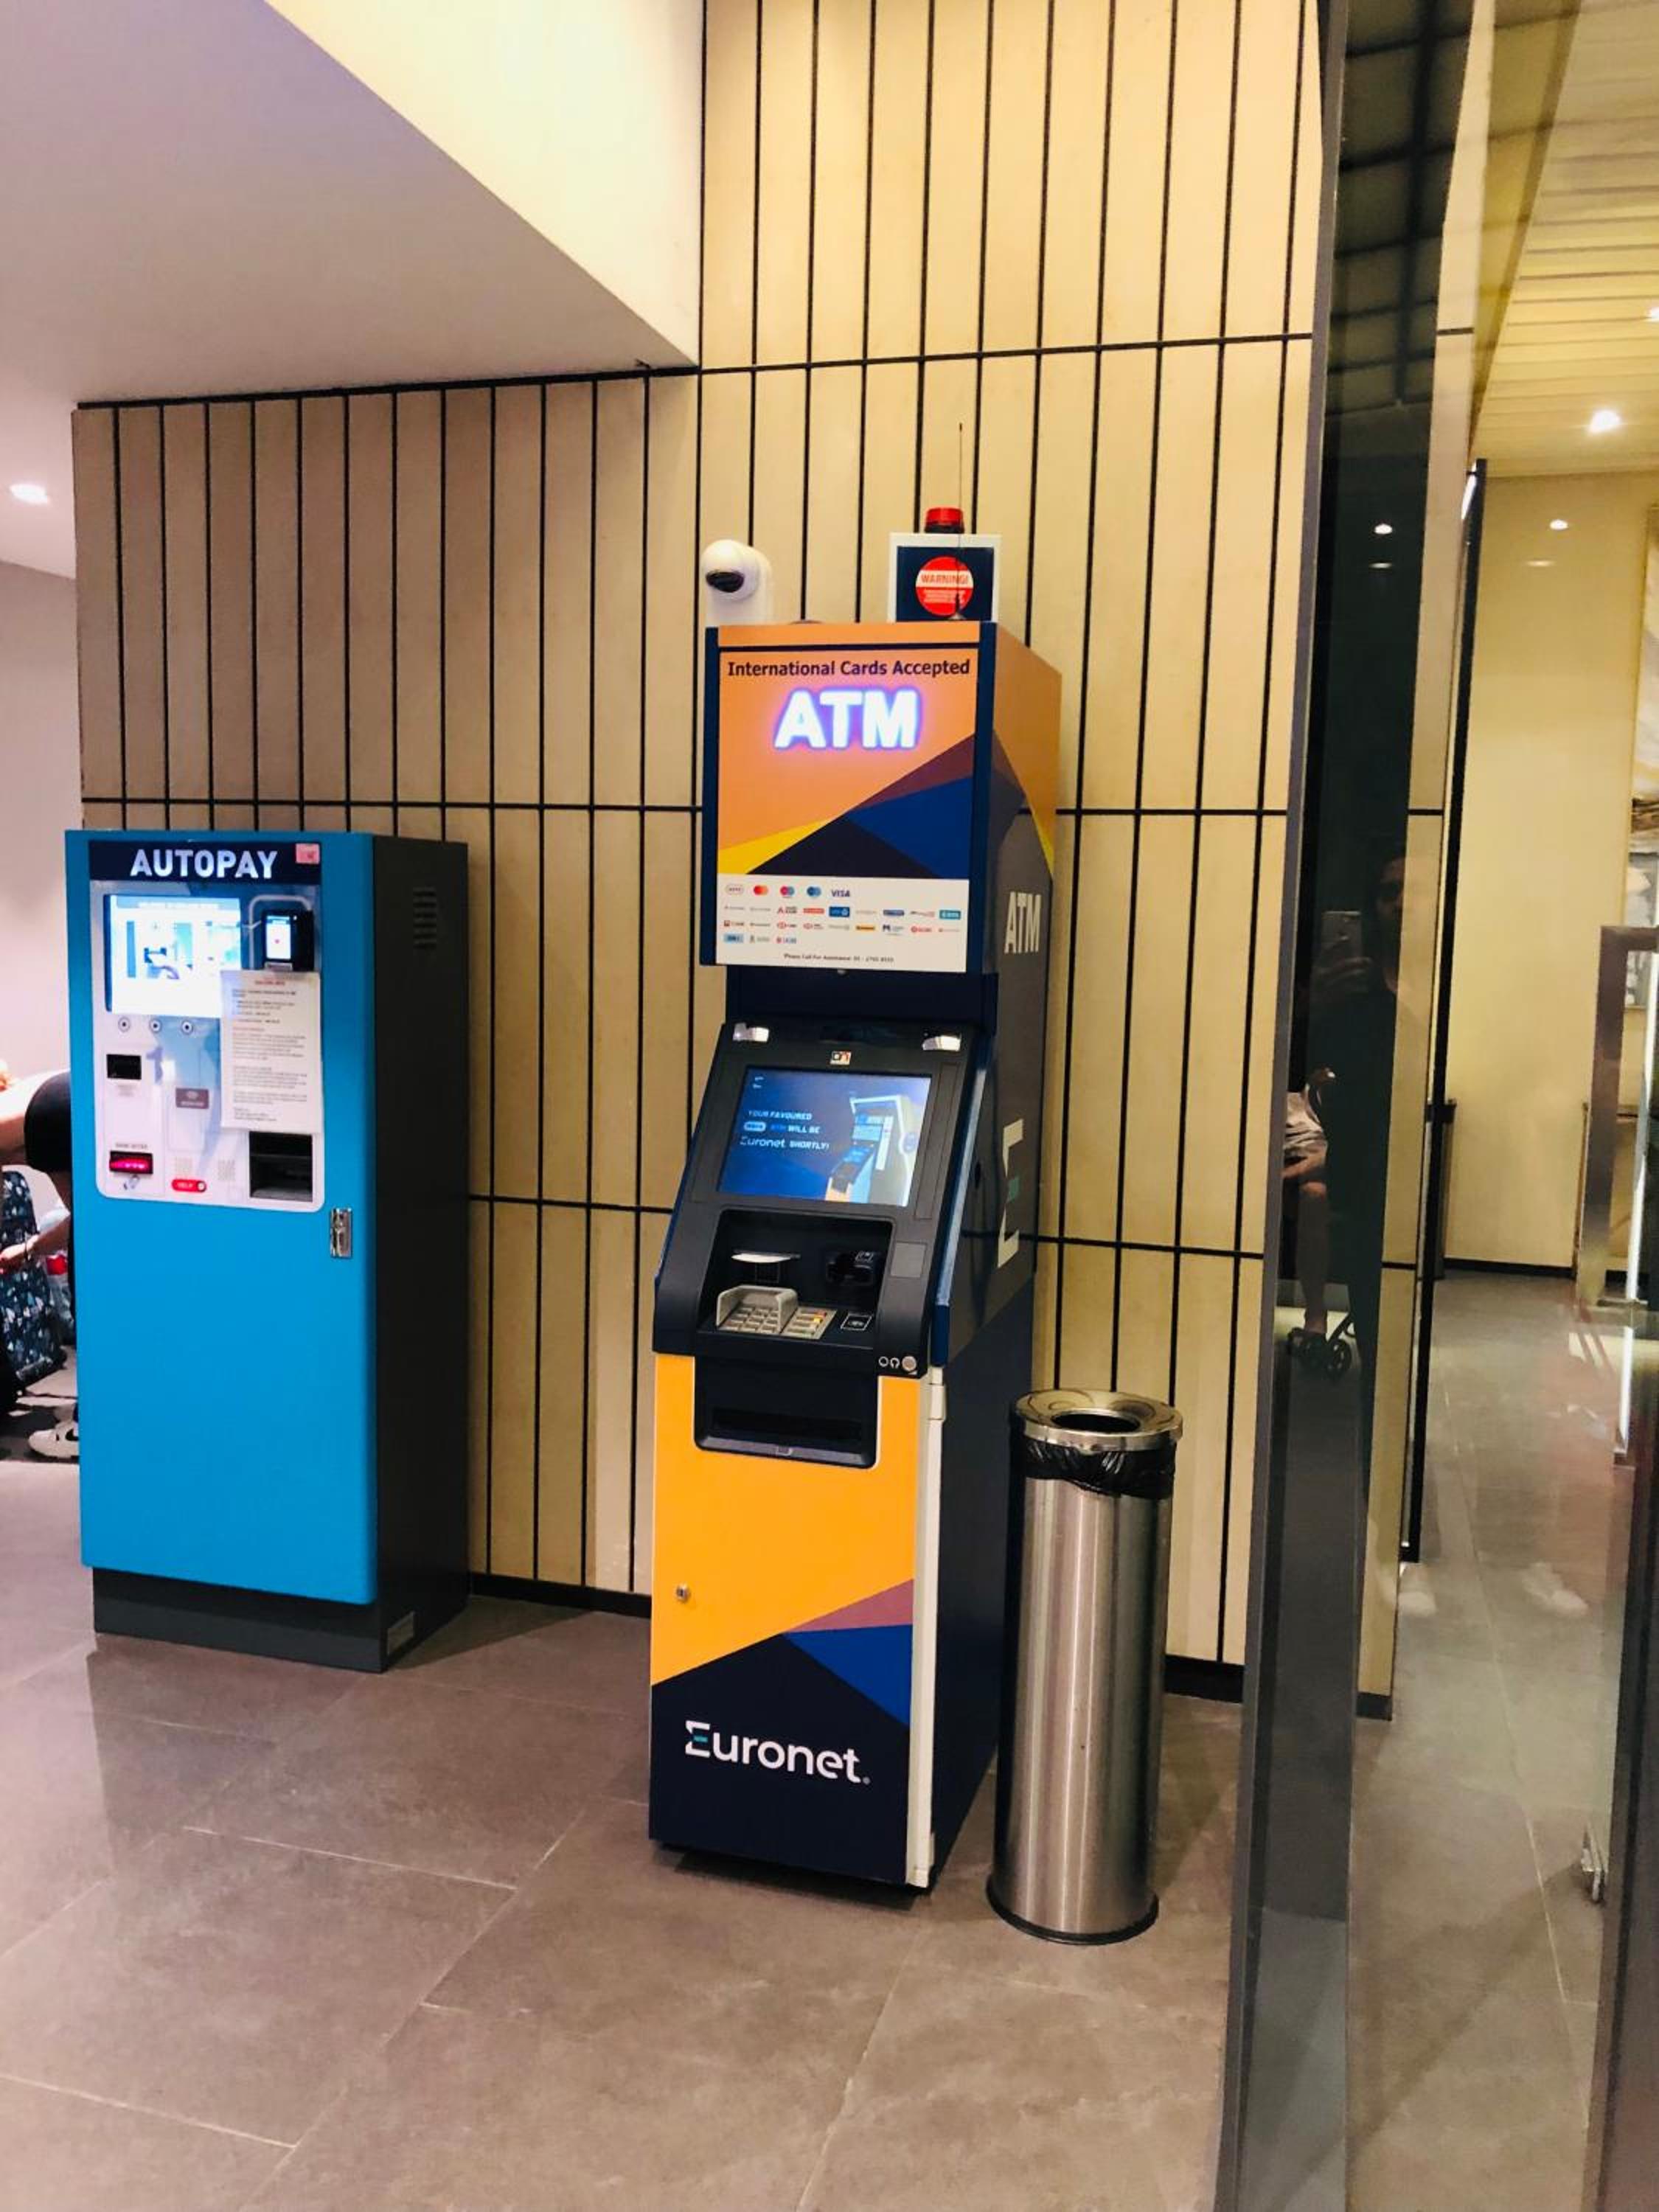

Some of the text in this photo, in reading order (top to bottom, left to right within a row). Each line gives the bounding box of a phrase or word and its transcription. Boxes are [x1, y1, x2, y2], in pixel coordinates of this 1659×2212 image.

[728, 659, 970, 678] International Cards Accepted
[773, 689, 918, 750] ATM
[130, 849, 277, 879] AUTOPAY
[831, 889, 850, 897] VISA
[1004, 891, 1041, 953] ATM
[788, 1124, 807, 1133] WILL
[740, 1136, 785, 1147] Euronet
[685, 1719, 862, 1784] Euronet
